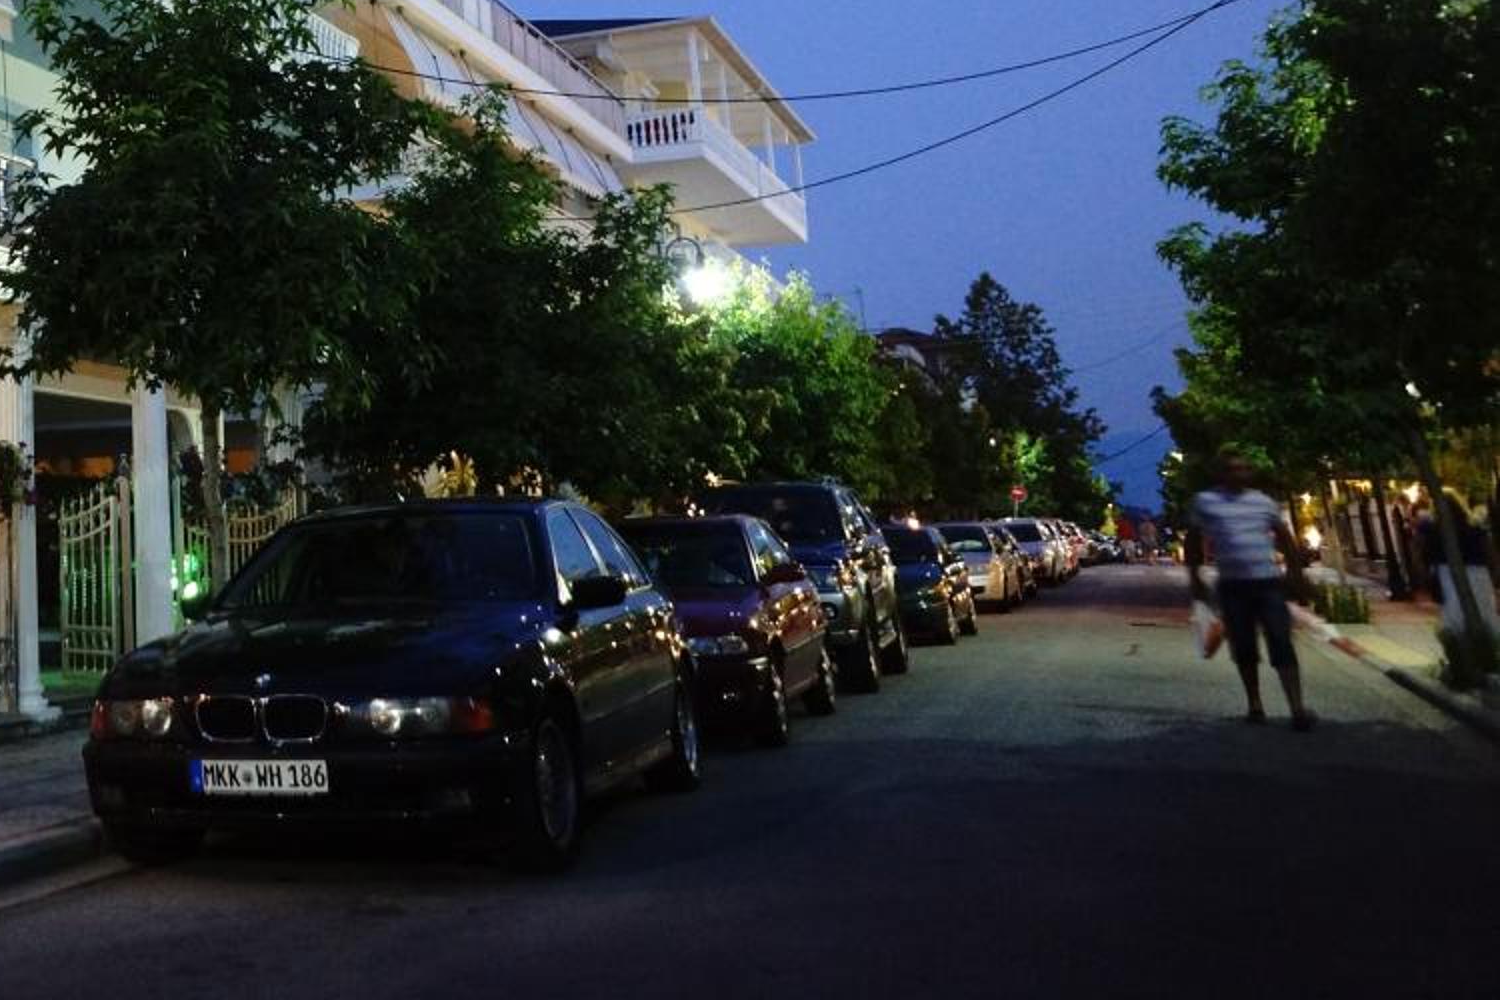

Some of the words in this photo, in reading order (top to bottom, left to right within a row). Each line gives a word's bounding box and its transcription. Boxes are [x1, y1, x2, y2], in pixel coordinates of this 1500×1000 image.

[203, 763, 240, 787] MKK
[255, 763, 282, 787] WH
[287, 763, 325, 788] 186
